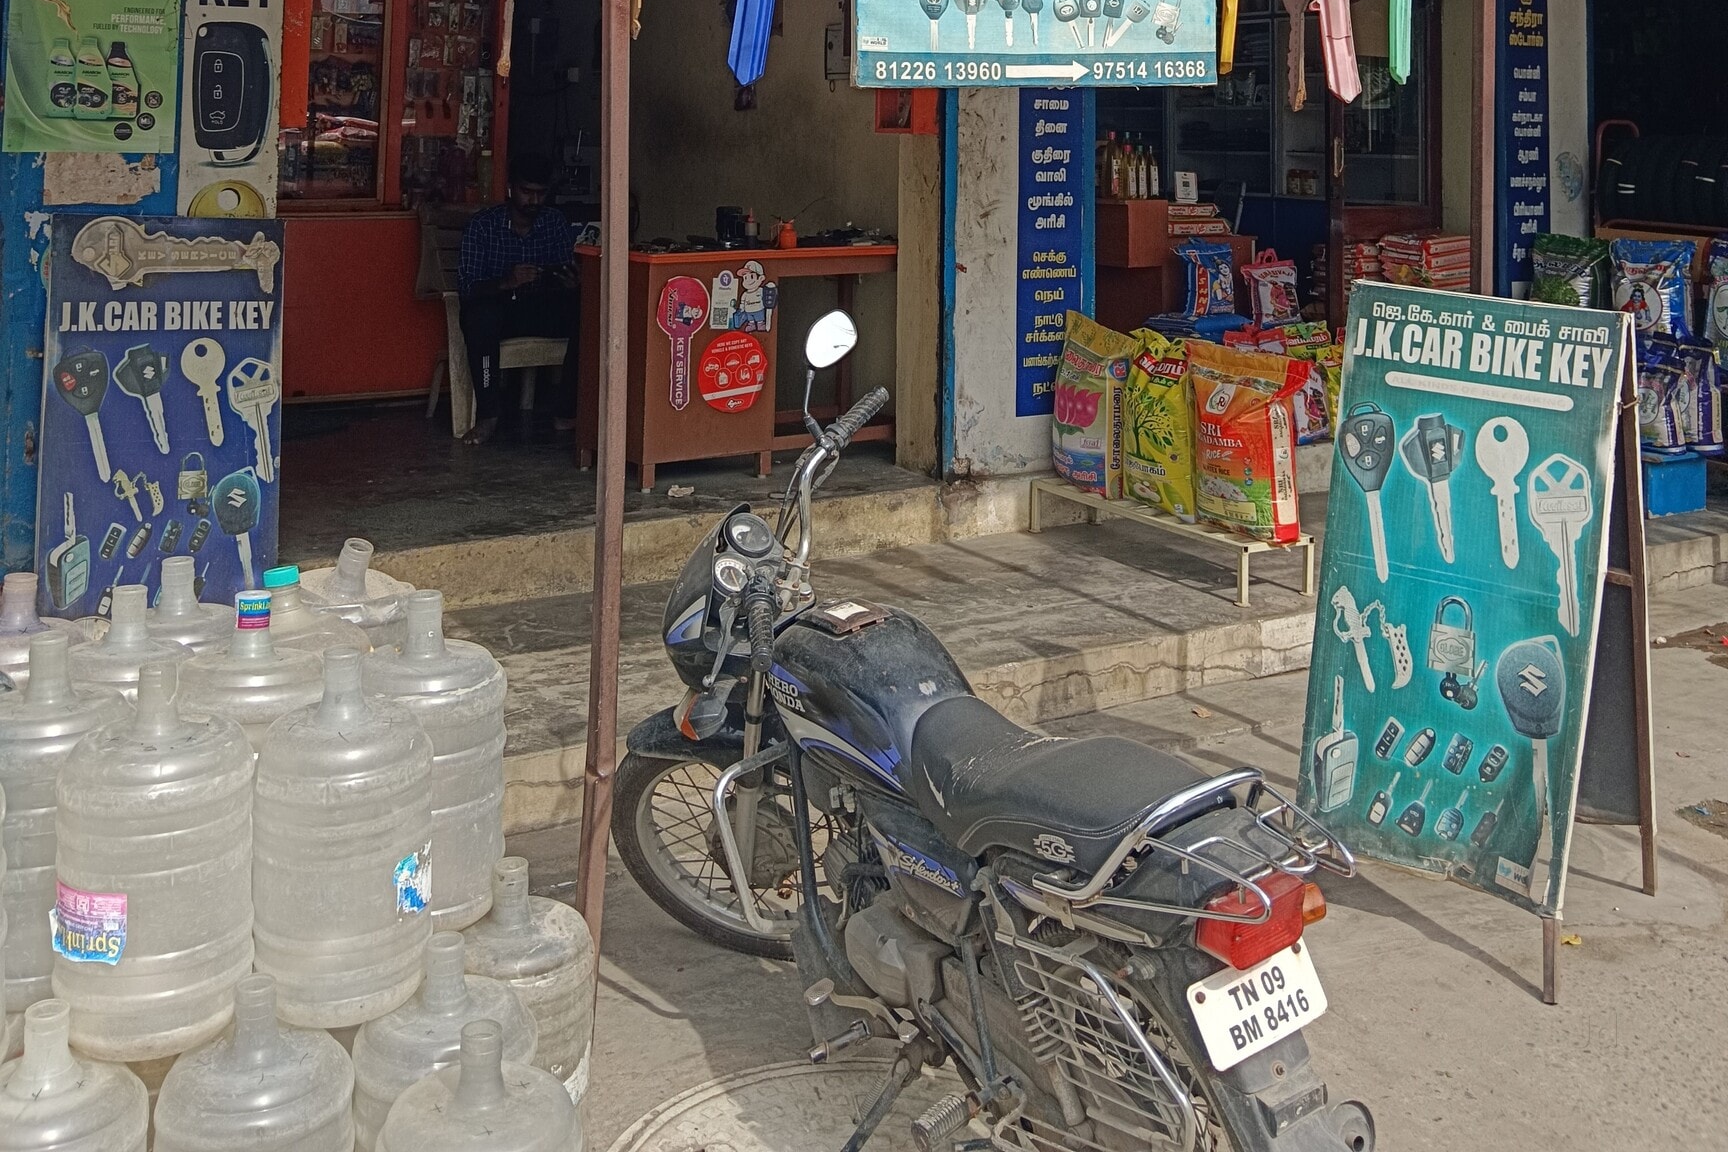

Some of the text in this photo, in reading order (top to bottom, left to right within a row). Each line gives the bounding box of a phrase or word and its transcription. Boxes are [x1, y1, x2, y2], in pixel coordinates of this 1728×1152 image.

[120, 24, 163, 33] TECHNOLOGY
[875, 59, 1206, 81] 81226 13960 97514 16368
[1034, 98, 1069, 110] சாமை
[1035, 119, 1067, 136] தினை
[1031, 147, 1071, 164] குதிரை
[1035, 168, 1067, 182] வாலி
[1028, 192, 1073, 210] மூங்கில்
[1035, 213, 1066, 229] அரிசி
[1032, 249, 1066, 263] செக்கு
[1022, 265, 1077, 279] எண்ணெய்
[1034, 287, 1064, 303] நெய்
[59, 301, 274, 332] J.K.CAR BIKE KEY
[1034, 313, 1063, 329] நாட்டு
[1482, 315, 1495, 332] &
[1504, 318, 1551, 338] பைக்
[1558, 327, 1609, 345] சாவி
[1353, 318, 1613, 389] J.K.CAR BIKE KEY
[675, 337, 685, 405] KEY SERVICE
[1201, 422, 1222, 436] SRI
[1206, 449, 1221, 459] RICE
[768, 672, 799, 696] HERO
[1041, 839, 1066, 856] 5G
[1228, 965, 1286, 1010] TN 09
[1229, 988, 1310, 1050] BM 8416
